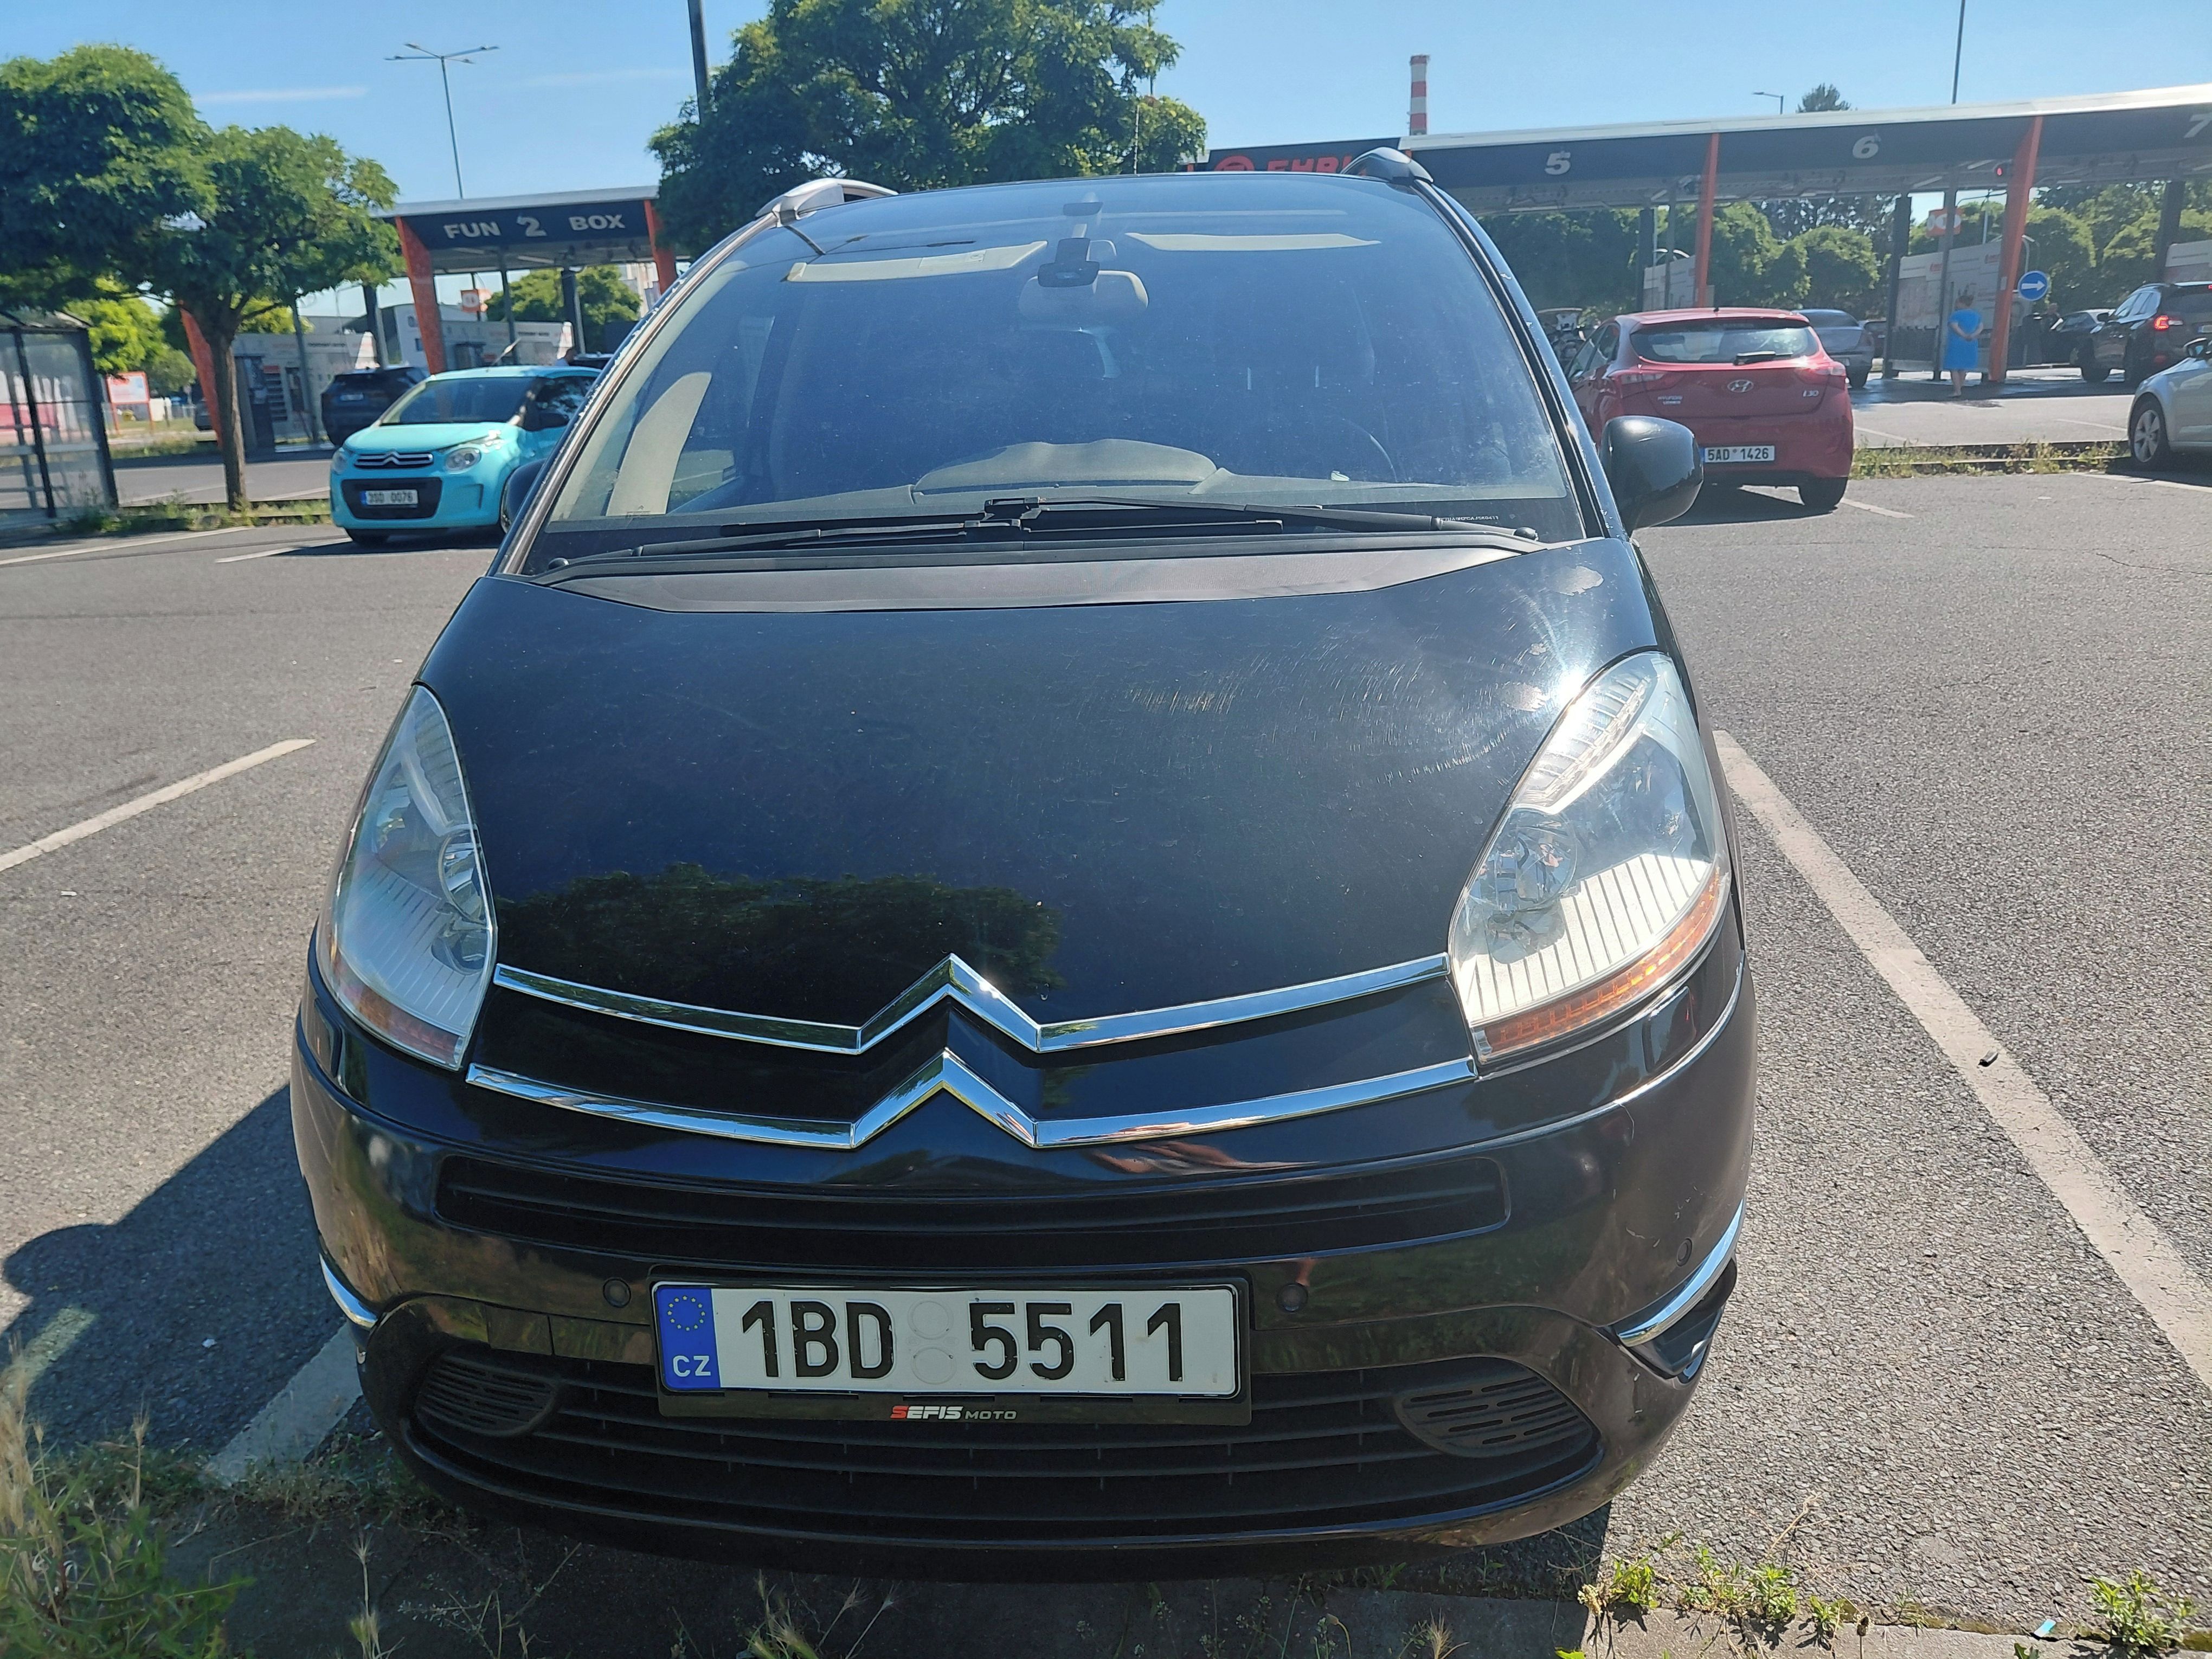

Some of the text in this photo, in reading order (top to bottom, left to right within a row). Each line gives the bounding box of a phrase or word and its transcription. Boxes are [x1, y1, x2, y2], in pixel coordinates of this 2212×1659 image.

[2184, 113, 2212, 138] 7
[1853, 135, 1879, 158] 6
[1544, 150, 1571, 175] 5
[443, 214, 626, 239] FUN 2 BOX
[1708, 447, 1769, 460] 5AD 1426
[742, 1301, 1183, 1381] 1BD 5511
[673, 1355, 711, 1377] CZ
[890, 1405, 1017, 1419] SEFIS MOTO
